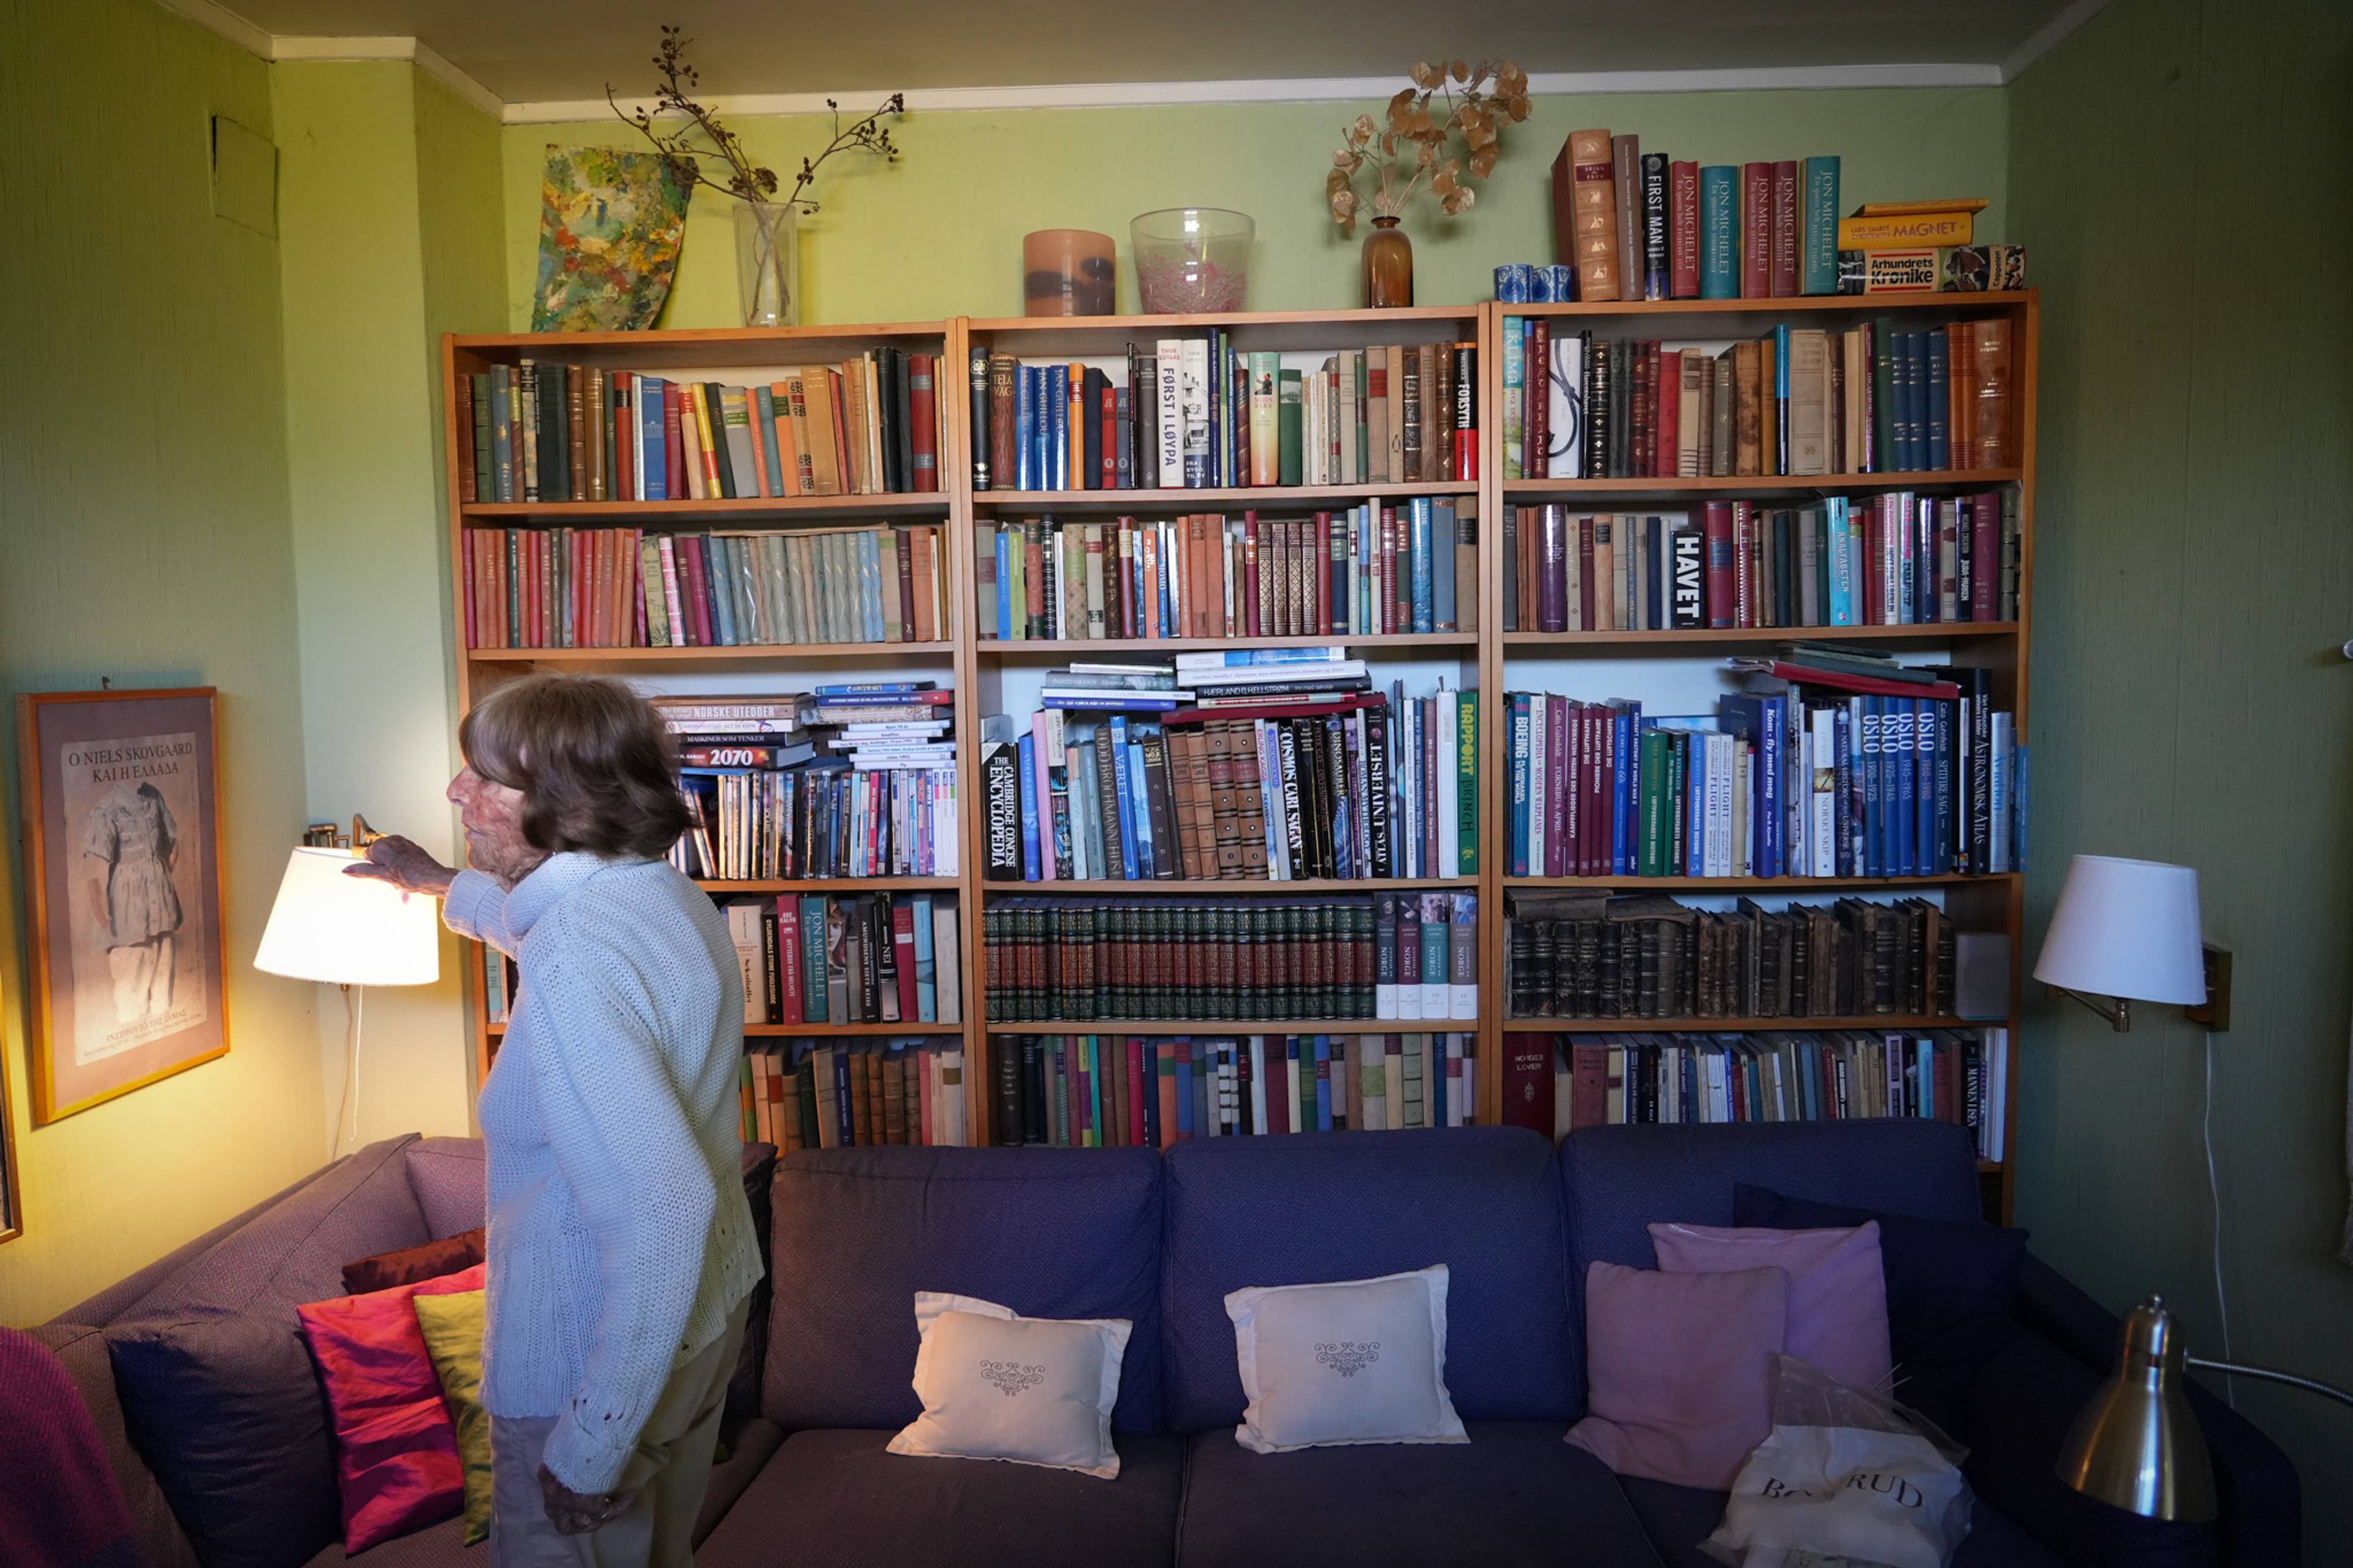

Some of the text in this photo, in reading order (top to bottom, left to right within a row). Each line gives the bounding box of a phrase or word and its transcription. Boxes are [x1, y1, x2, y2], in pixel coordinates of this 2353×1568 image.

[1648, 175, 1662, 210] FIRST
[1649, 216, 1663, 244] MAN
[1683, 175, 1695, 272] JON MICHELET
[1718, 180, 1729, 276] JON MICHELET
[1756, 176, 1768, 274] JON MICHELET
[1781, 176, 1794, 274] JON MICHELET
[1819, 170, 1833, 268] JON MICHELET
[1893, 221, 1957, 237] MAGNET
[1871, 268, 1933, 285] Krønike
[1993, 249, 2001, 287] Cappelen
[1038, 372, 1048, 436] JAN GUILLOU
[1055, 369, 1065, 433] JAN GUILLOU
[1163, 368, 1176, 466] FØRST LØYPA
[1458, 384, 1470, 428] FORSYTH
[1677, 537, 1700, 618] HAVET
[1838, 530, 1849, 592] ANALFABETEN
[1204, 684, 1289, 696] HÆRLAND HELLSTRØM
[1939, 702, 1948, 718] Cato
[694, 706, 729, 718] NORSKE
[1898, 712, 1914, 751] OSLO
[1917, 712, 1935, 752] OSLO
[69, 741, 192, 767] O NIELS SKOVGAARD
[1056, 729, 1065, 759] Hedgecoe
[1097, 737, 1107, 762] ODD
[1461, 703, 1474, 775] RAPPORT
[1515, 716, 1528, 758] BOEING
[1765, 708, 1775, 799] Kom fly med meg
[1863, 714, 1880, 754] OSLO
[1881, 714, 1899, 754] OSLO
[1939, 721, 1949, 752] Guhnfeldt
[93, 762, 180, 783] ΚΑΙ Η ΕΛΛΑΔΑ
[710, 749, 753, 766] 2070
[1115, 754, 1126, 797] VÆRET
[1334, 731, 1346, 797] DINOSAURER
[1938, 759, 1949, 794] SPITFIRE
[1280, 732, 1303, 849] COSMOS CARL SAGAN
[1370, 743, 1386, 863] ATLAS UNIVERSET
[1460, 779, 1474, 832] BRINCH
[1722, 777, 1730, 819] FLIGHT
[1938, 795, 1949, 816] SAGA
[989, 766, 1006, 867] ENCYCLOPEDIA
[1004, 766, 1016, 867] CAMBRIDGE CONCISE
[1534, 797, 1543, 835] WARPLANES
[1820, 796, 1830, 856] NORSKE SKIP
[767, 918, 775, 954] GYLDENDALS
[809, 911, 827, 999] JON MICHELET
[861, 920, 870, 964] AMUNDSENS
[882, 945, 892, 964] NEI
[1514, 1054, 1544, 1062] NORGES
[1517, 1062, 1542, 1071] LOVER
[1968, 1067, 1979, 1102] MANNEN
